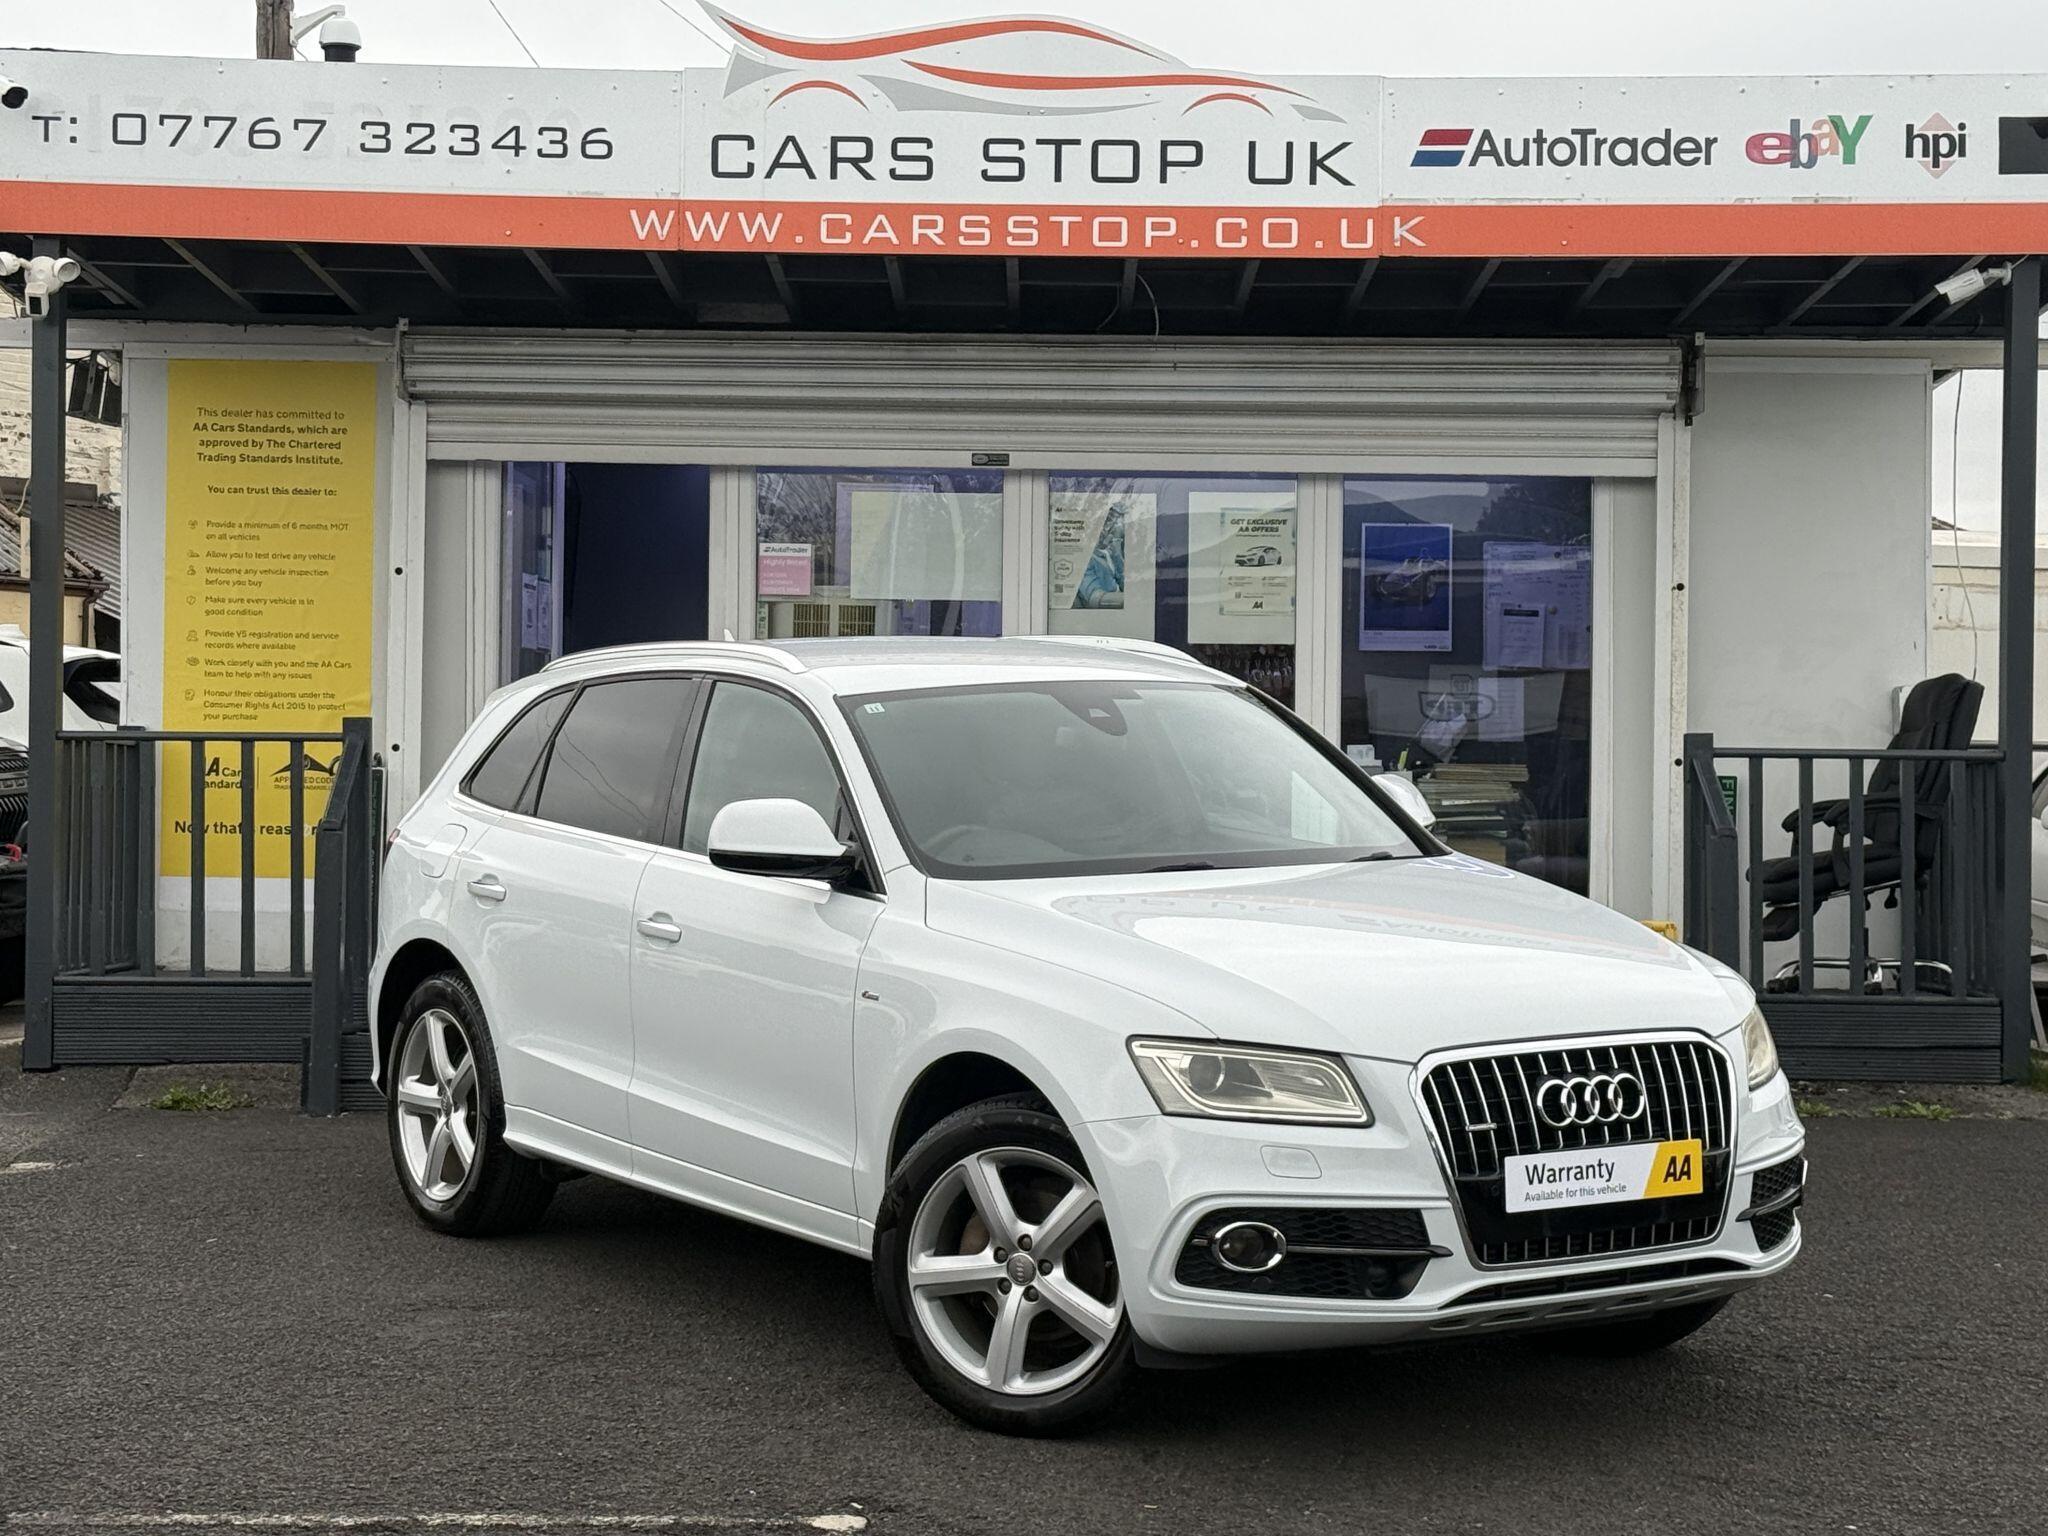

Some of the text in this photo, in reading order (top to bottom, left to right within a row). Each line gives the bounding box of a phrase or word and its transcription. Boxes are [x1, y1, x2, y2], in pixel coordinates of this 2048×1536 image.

[111, 112, 327, 152] 07767
[359, 120, 614, 161] 323436
[1468, 128, 1718, 167] AutoTrader
[1905, 123, 1967, 169] hpi
[711, 135, 1355, 187] CARS STOP UK
[197, 407, 345, 420] This dealer has committed to
[193, 423, 348, 435] AA Cars Standards, which are
[199, 439, 341, 450] approved by The Chartered
[197, 453, 343, 465] Trading Standards Institute.
[208, 485, 337, 497] You can trust this dealer to:
[206, 521, 236, 529] Provide
[244, 521, 280, 529] minimum
[282, 521, 291, 529] of
[292, 521, 297, 529] 6
[299, 523, 328, 531] months
[330, 523, 349, 531] MOT
[218, 533, 227, 541] all
[228, 533, 260, 542] vehicles
[205, 551, 228, 559] Allow
[229, 553, 244, 561] you
[255, 552, 269, 560] test
[272, 552, 291, 560] drive
[308, 553, 336, 561] vehicle
[205, 567, 329, 577] Welcome any vehicle inspection
[205, 578, 262, 588] before you buy
[205, 596, 226, 604] Make
[246, 598, 268, 606] every
[1252, 601, 1264, 609] AA
[205, 608, 263, 616] good condition
[205, 630, 235, 638] Provide
[248, 631, 293, 640] registration
[227, 659, 254, 668] closely
[274, 661, 289, 669] you
[334, 661, 352, 669] Cars
[235, 671, 252, 679] help
[253, 691, 296, 700] obligations
[298, 691, 321, 699] under
[203, 701, 243, 709] Consumer
[245, 702, 270, 711] Rights
[286, 702, 306, 710] 2015
[317, 703, 346, 711] protect
[222, 713, 258, 721] purchase
[1525, 1158, 1615, 1185] Warranty
[1663, 1154, 1691, 1183] AA
[1524, 1183, 1626, 1201] Available for this vehicle
